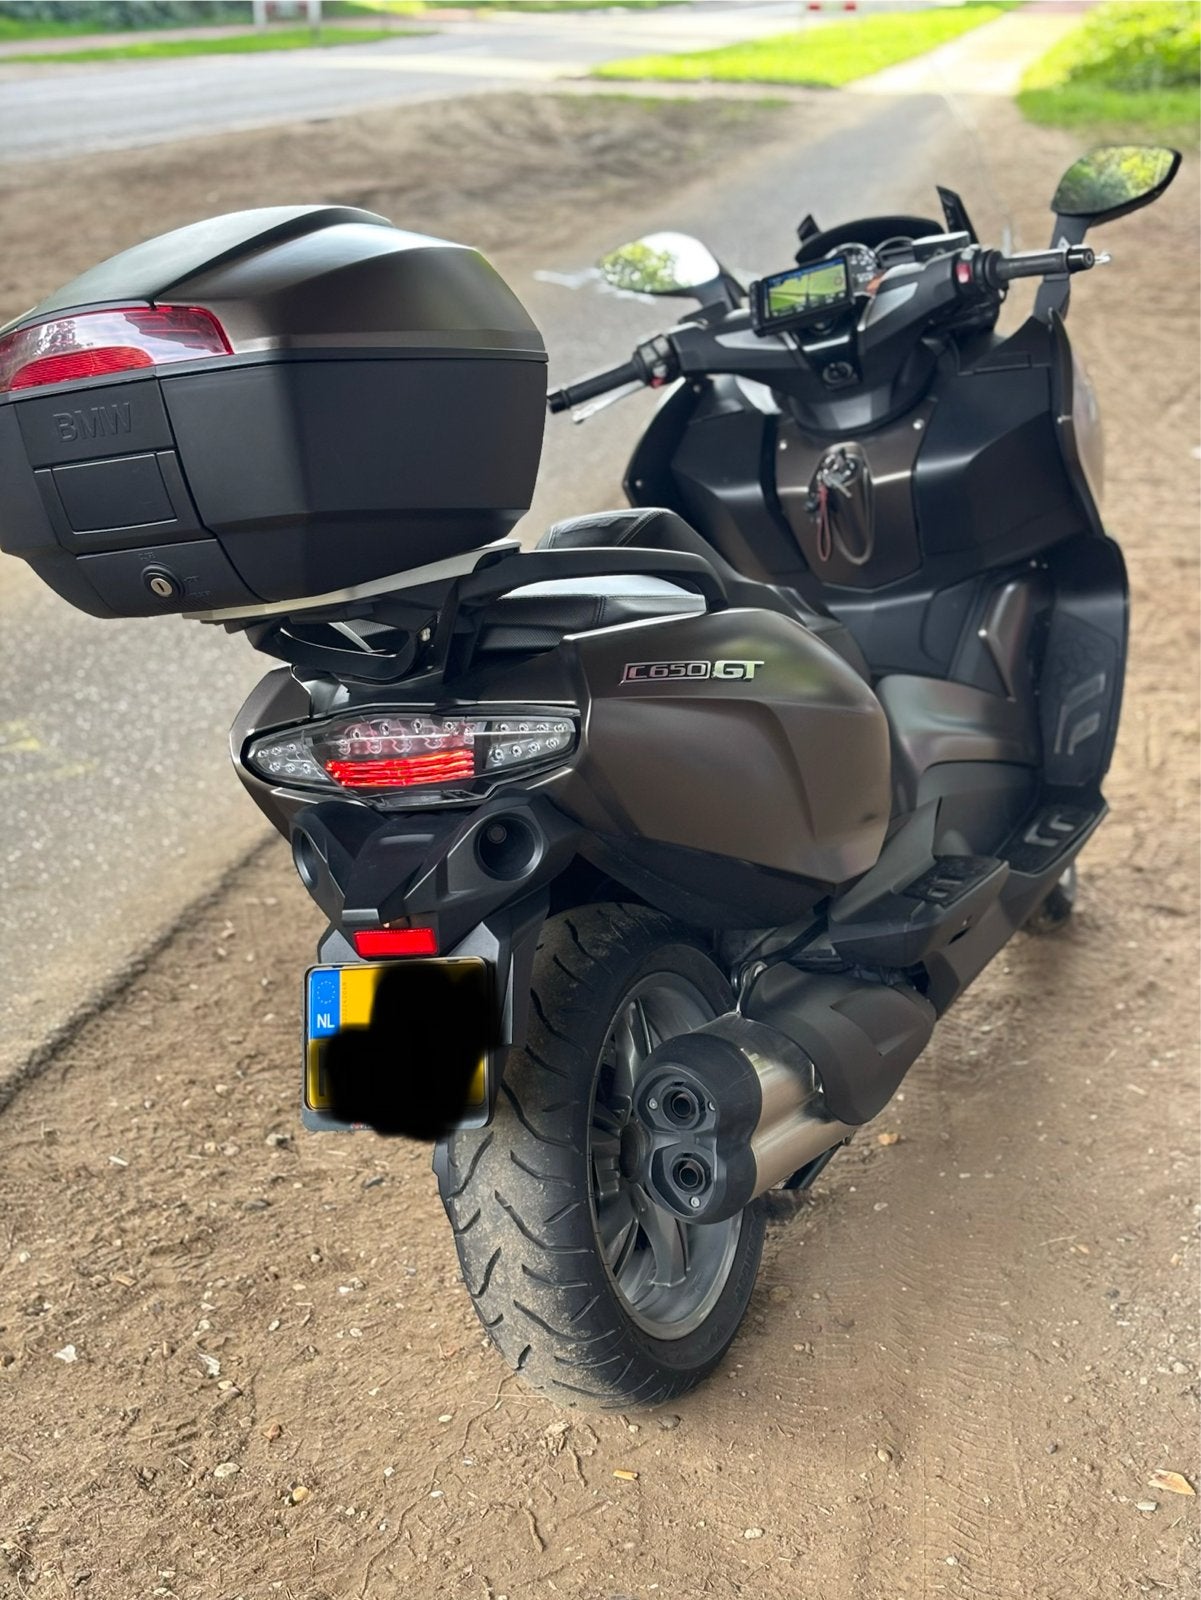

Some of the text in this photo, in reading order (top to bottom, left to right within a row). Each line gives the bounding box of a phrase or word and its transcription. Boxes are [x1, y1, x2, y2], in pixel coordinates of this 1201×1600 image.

[53, 402, 132, 442] BMW
[712, 660, 765, 679] GT
[316, 1013, 335, 1029] NL
